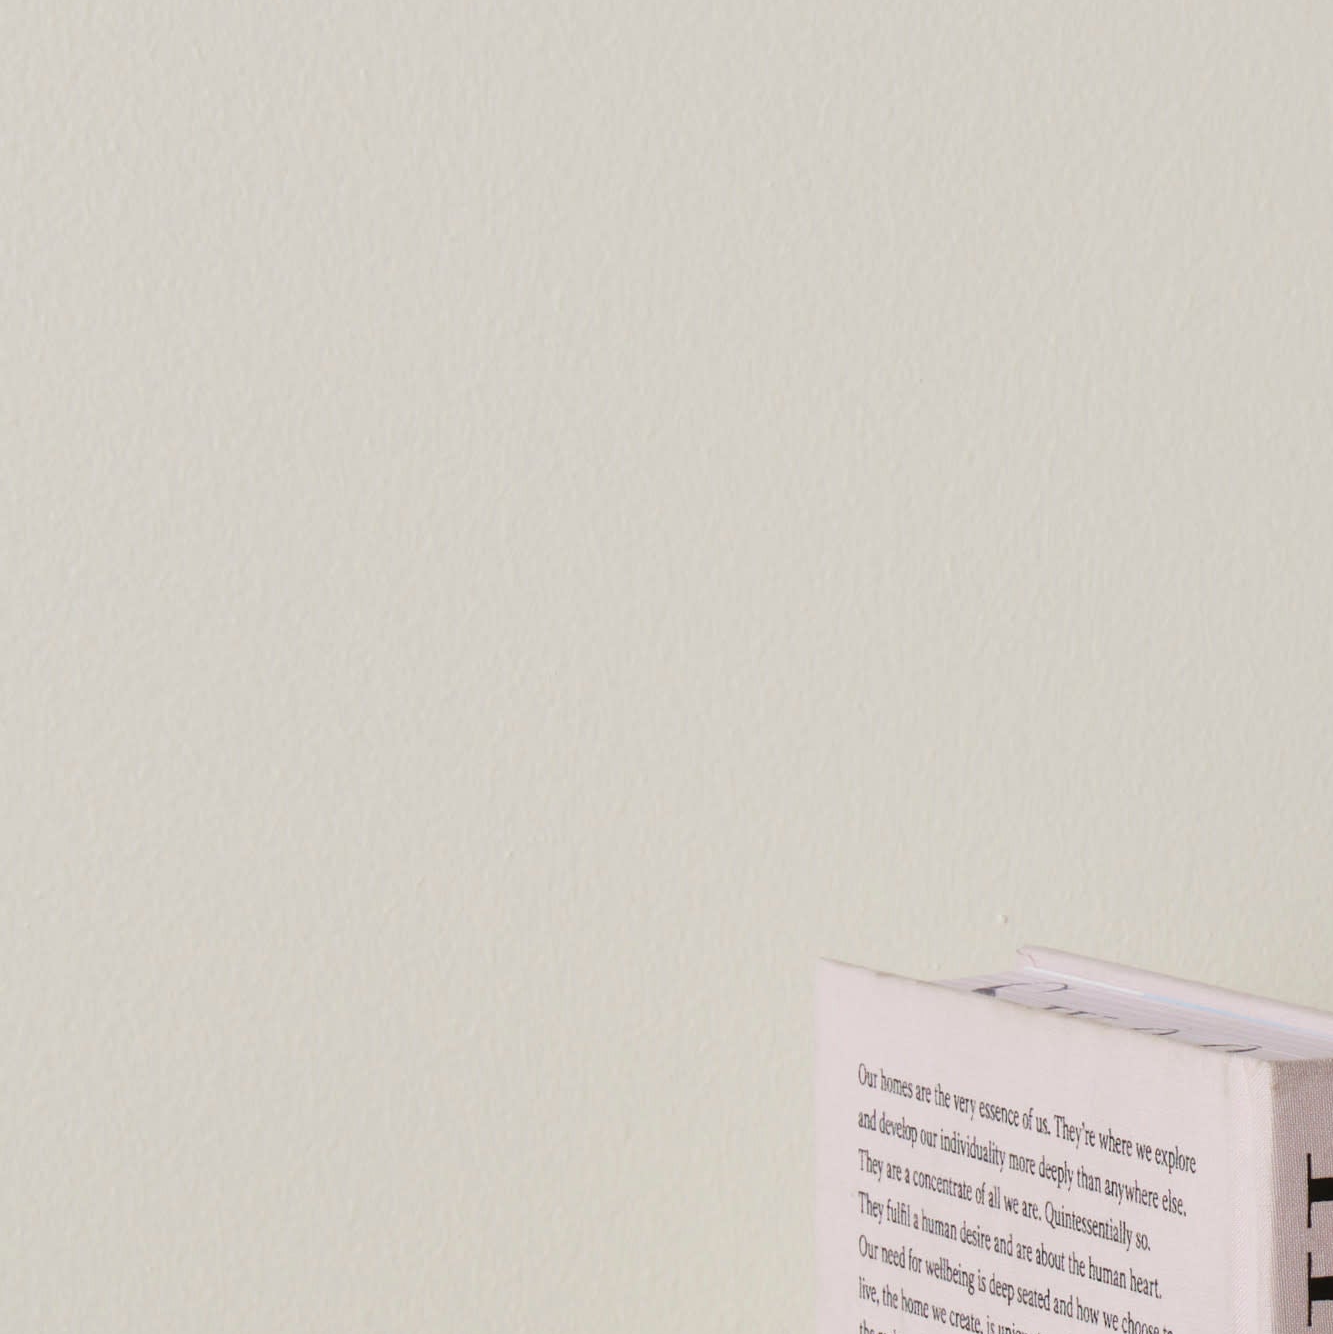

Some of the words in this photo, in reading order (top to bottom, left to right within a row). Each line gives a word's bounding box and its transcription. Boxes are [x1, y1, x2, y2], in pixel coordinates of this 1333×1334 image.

[858, 1063, 878, 1089] Our
[880, 1068, 913, 1099] homes
[916, 1085, 932, 1103] are
[934, 1083, 951, 1109] the
[953, 1094, 976, 1121] very
[979, 1101, 1020, 1127] essence
[1022, 1107, 1034, 1130] of
[1036, 1116, 1051, 1136] us.
[1054, 1115, 1095, 1149] They're
[1099, 1128, 1133, 1157] where
[1136, 1142, 1152, 1162] we
[1155, 1145, 1196, 1174] explore
[858, 1109, 877, 1131] and
[879, 1111, 918, 1148] develop
[920, 1129, 938, 1148] our
[940, 1128, 1006, 1173] individuality
[1009, 1153, 1036, 1176] more
[1039, 1155, 1074, 1192] deeply
[1077, 1165, 1101, 1193] than
[1105, 1179, 1160, 1209] anywhere
[1162, 1189, 1186, 1217] else.
[858, 1148, 884, 1182] They
[887, 1163, 902, 1182] are
[904, 1168, 910, 1184] a
[913, 1171, 972, 1201] concentrate
[975, 1182, 986, 1205] of
[988, 1186, 1000, 1209] all
[1004, 1195, 1019, 1214] we
[1022, 1200, 1041, 1221] are.
[1045, 1201, 1133, 1251] Quintessentially
[1136, 1232, 1151, 1251] so.
[858, 1191, 884, 1225] They
[886, 1198, 910, 1227] fulfil
[913, 1213, 919, 1230] a
[921, 1209, 957, 1241] human
[960, 1220, 991, 1251] desire
[994, 1233, 1013, 1257] and
[1016, 1243, 1032, 1262] are
[1036, 1243, 1065, 1272] about
[1068, 1251, 1085, 1277] the
[1088, 1256, 1126, 1289] human
[1129, 1268, 1162, 1299] heart.
[859, 1235, 879, 1260] Our
[881, 1246, 906, 1269] need
[909, 1248, 922, 1273] for
[925, 1257, 975, 1296] wellbeing
[978, 1269, 986, 1293] is
[989, 1273, 1015, 1306] deep
[1017, 1287, 1050, 1312] seated
[1053, 1295, 1073, 1318] and
[1076, 1296, 1100, 1325] how
[1102, 1311, 1119, 1331] we
[859, 1276, 879, 1306] live,
[882, 1284, 898, 1309] the
[901, 1288, 929, 1319] home
[931, 1305, 947, 1324] we
